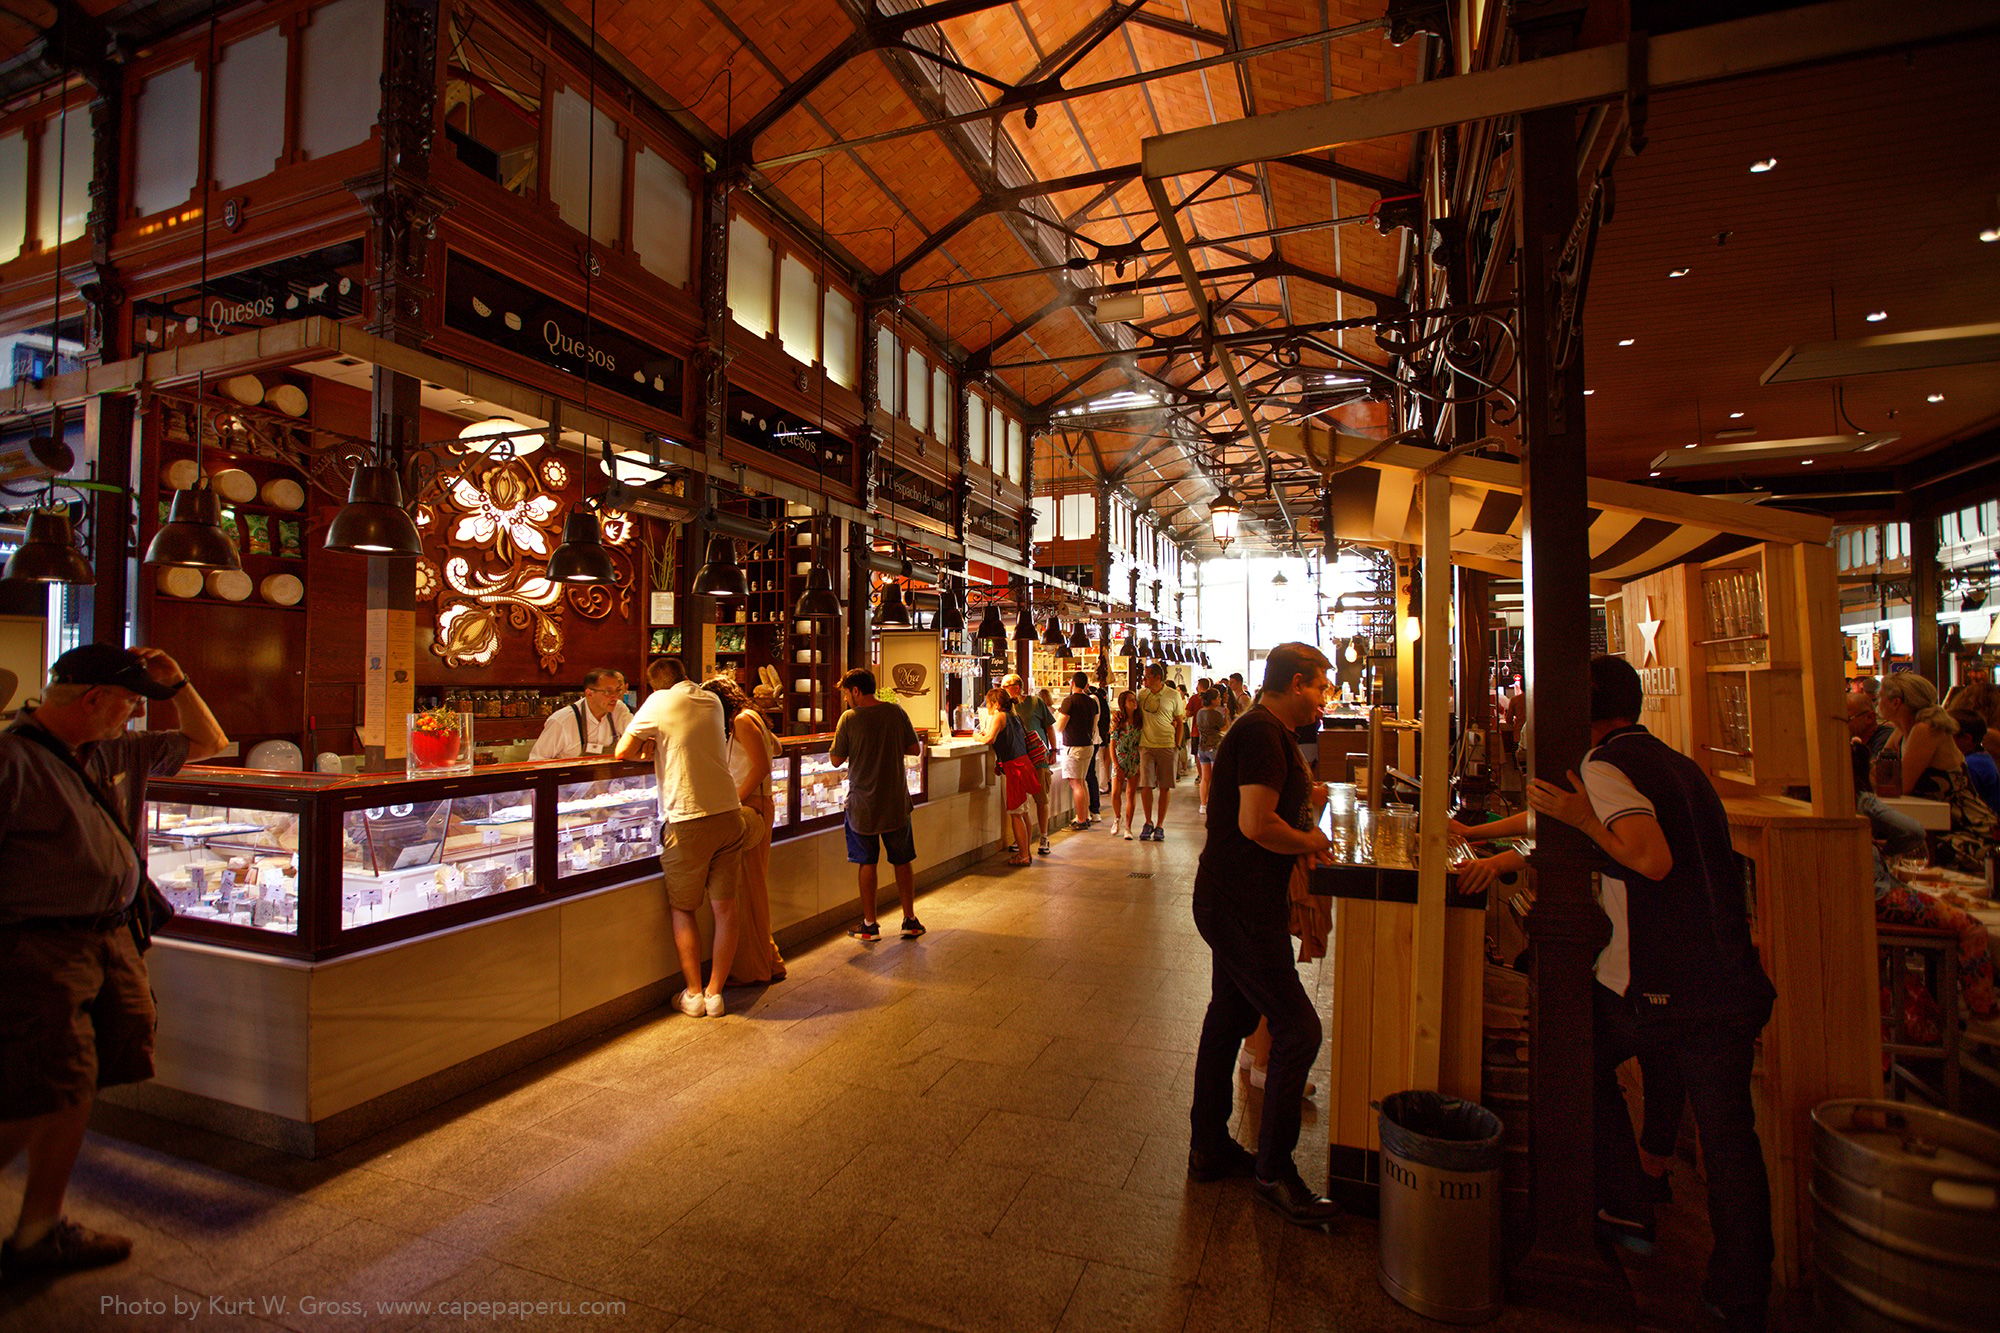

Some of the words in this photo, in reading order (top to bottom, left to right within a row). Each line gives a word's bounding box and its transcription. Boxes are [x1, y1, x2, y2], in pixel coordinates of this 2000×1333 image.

[210, 296, 275, 336] Quesos
[543, 319, 616, 372] Quesos
[777, 420, 817, 453] Quesos
[1634, 667, 1679, 695] TRELLA
